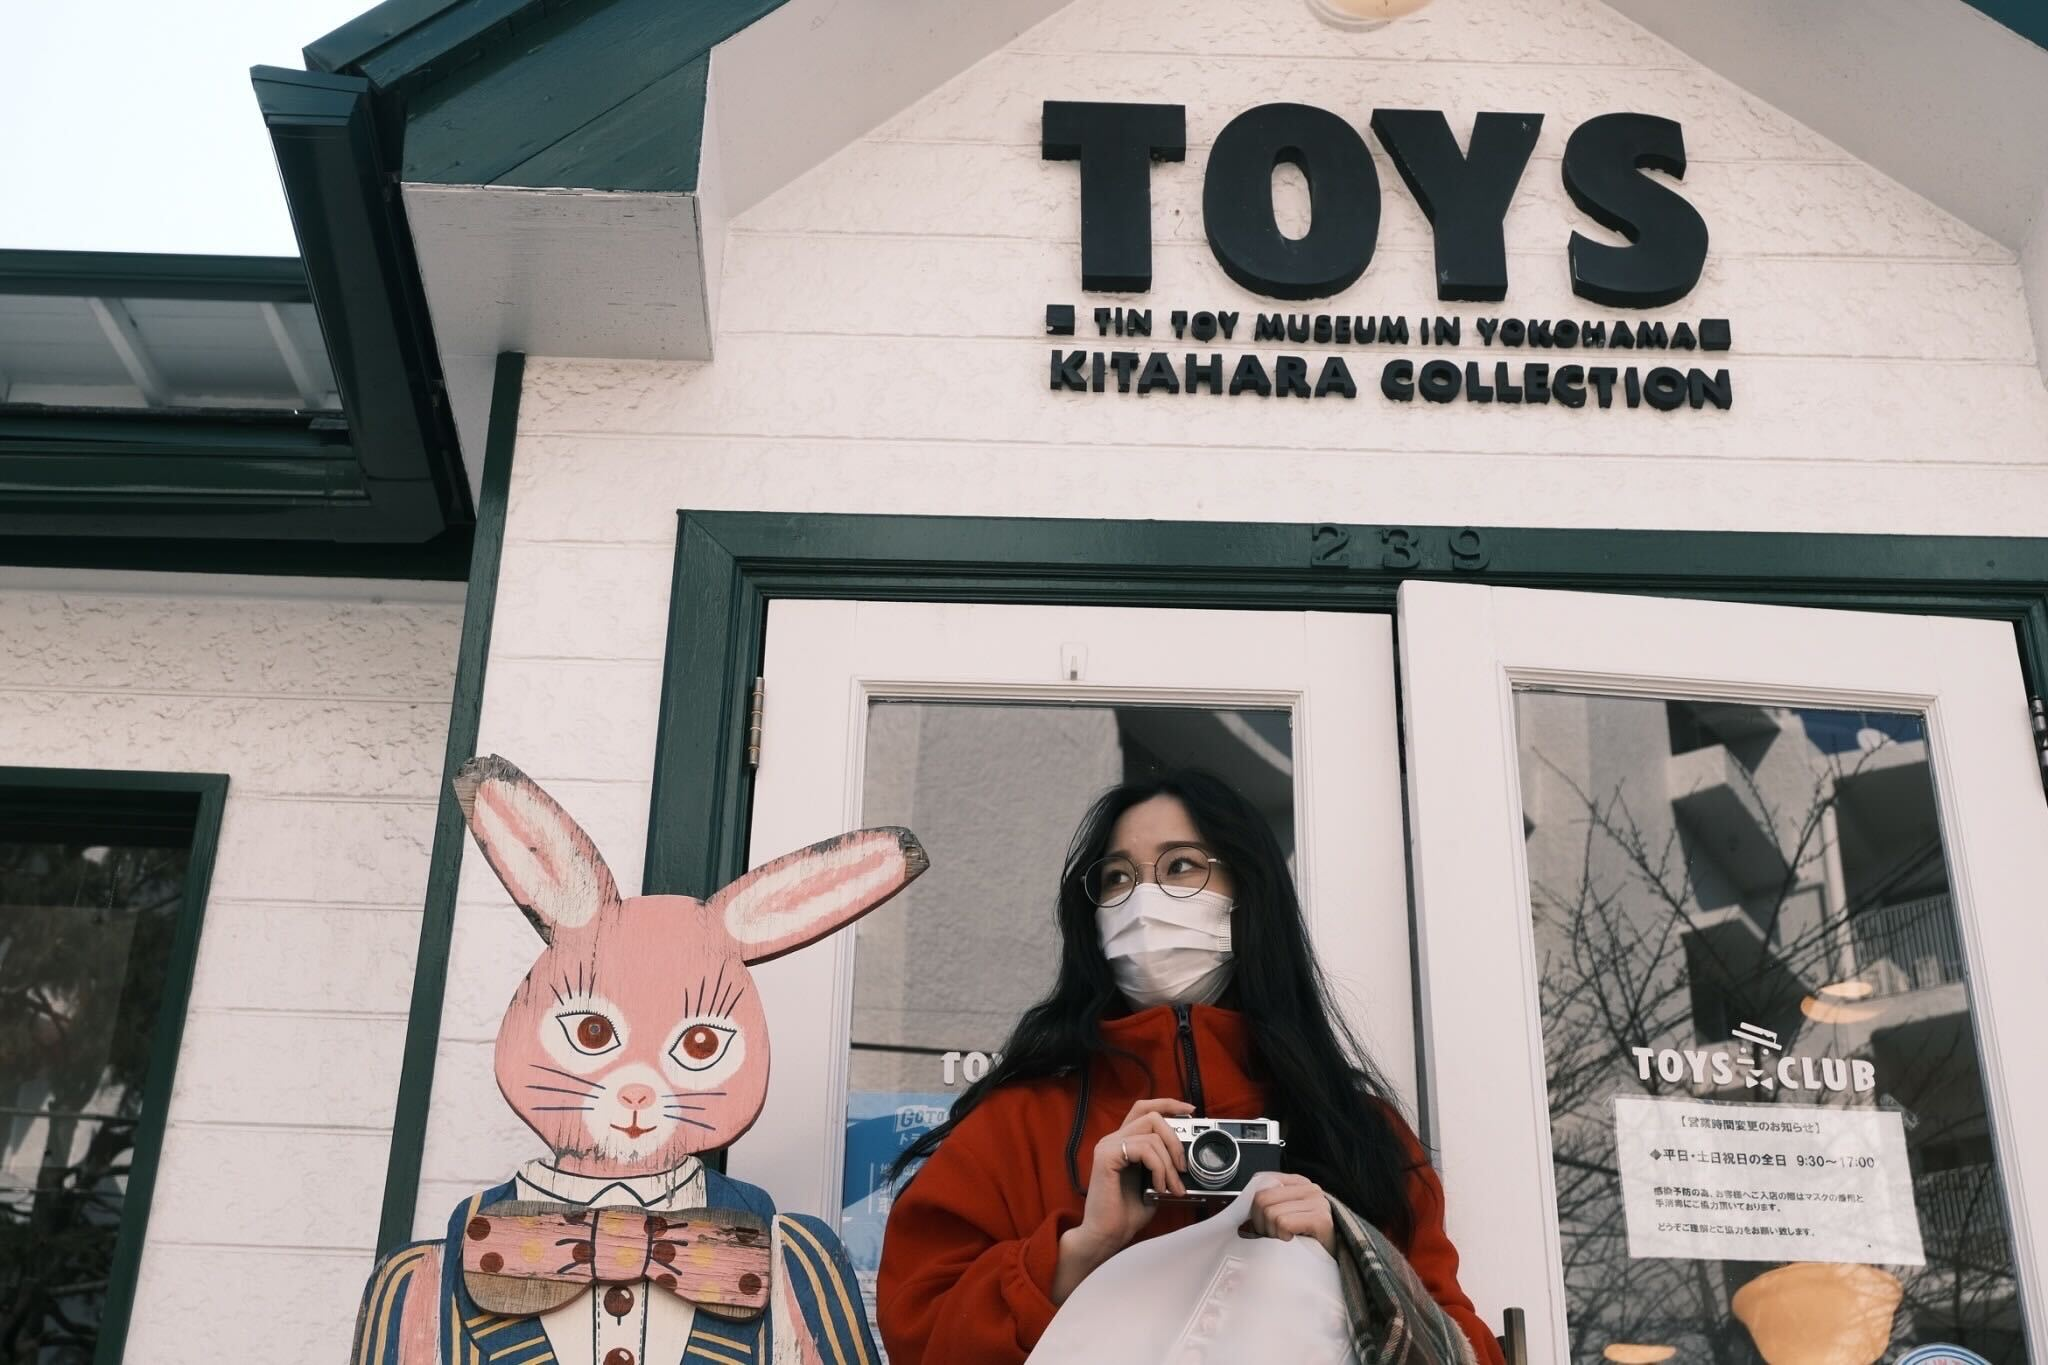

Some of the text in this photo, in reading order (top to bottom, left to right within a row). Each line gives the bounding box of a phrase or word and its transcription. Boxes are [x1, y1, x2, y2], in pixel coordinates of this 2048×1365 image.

[1042, 101, 1709, 309] TOYS
[1094, 306, 1697, 350] TIN TOY MUSEUM IN YOKOHAMA
[1050, 349, 1732, 411] KITAHARA COLLECTION
[1310, 523, 1491, 571] 239
[1632, 1046, 1876, 1092] TOYS CLUB
